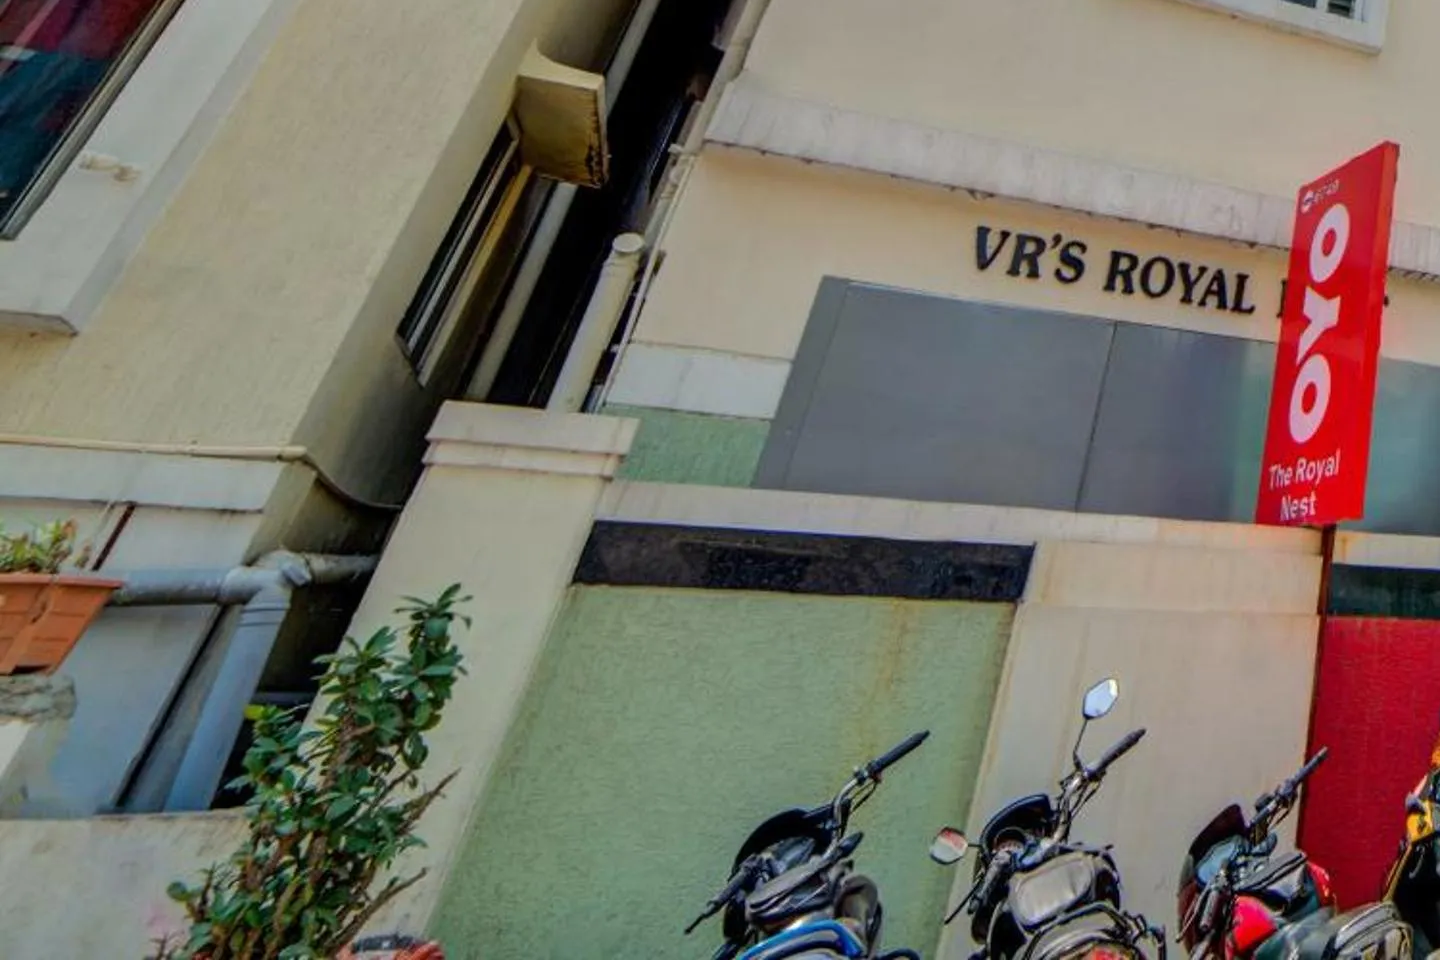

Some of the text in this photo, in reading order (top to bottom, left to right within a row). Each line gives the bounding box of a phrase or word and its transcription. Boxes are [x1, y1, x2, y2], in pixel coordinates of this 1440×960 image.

[976, 225, 1087, 284] VR'S
[1103, 250, 1256, 316] ROYAL
[1289, 203, 1350, 444] OYO
[1269, 448, 1341, 490] The Royal
[1281, 490, 1317, 521] Nest
